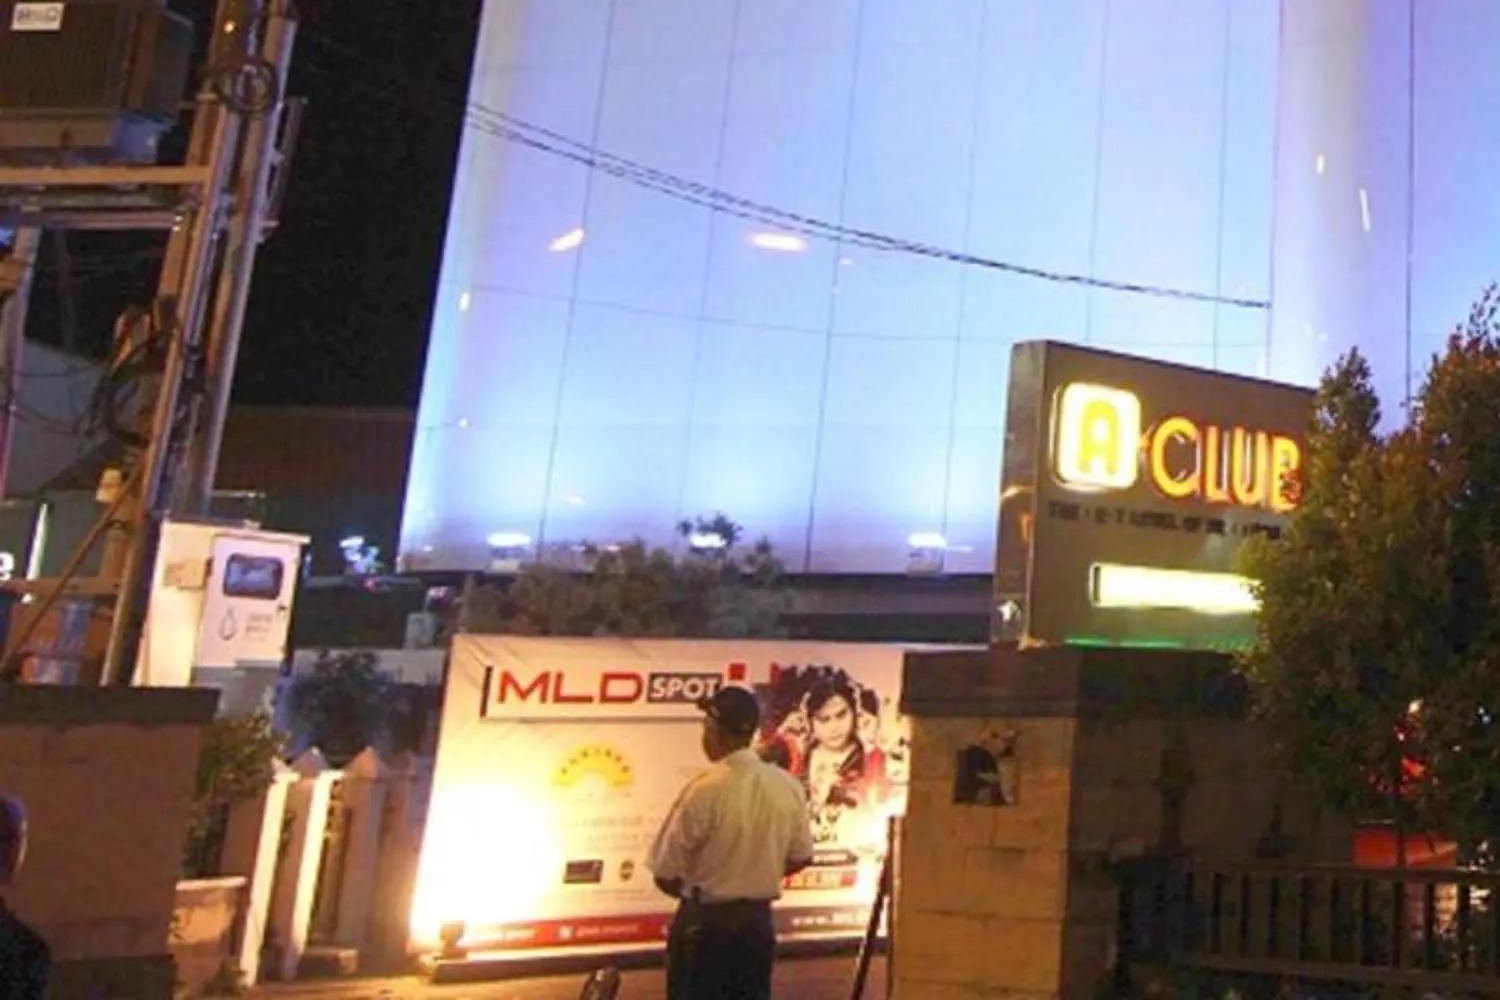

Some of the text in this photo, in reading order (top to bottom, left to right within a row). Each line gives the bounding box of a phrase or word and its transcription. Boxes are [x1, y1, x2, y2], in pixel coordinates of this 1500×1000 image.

[1077, 399, 1302, 512] A CLUB
[497, 669, 720, 704] MLD SPOT
